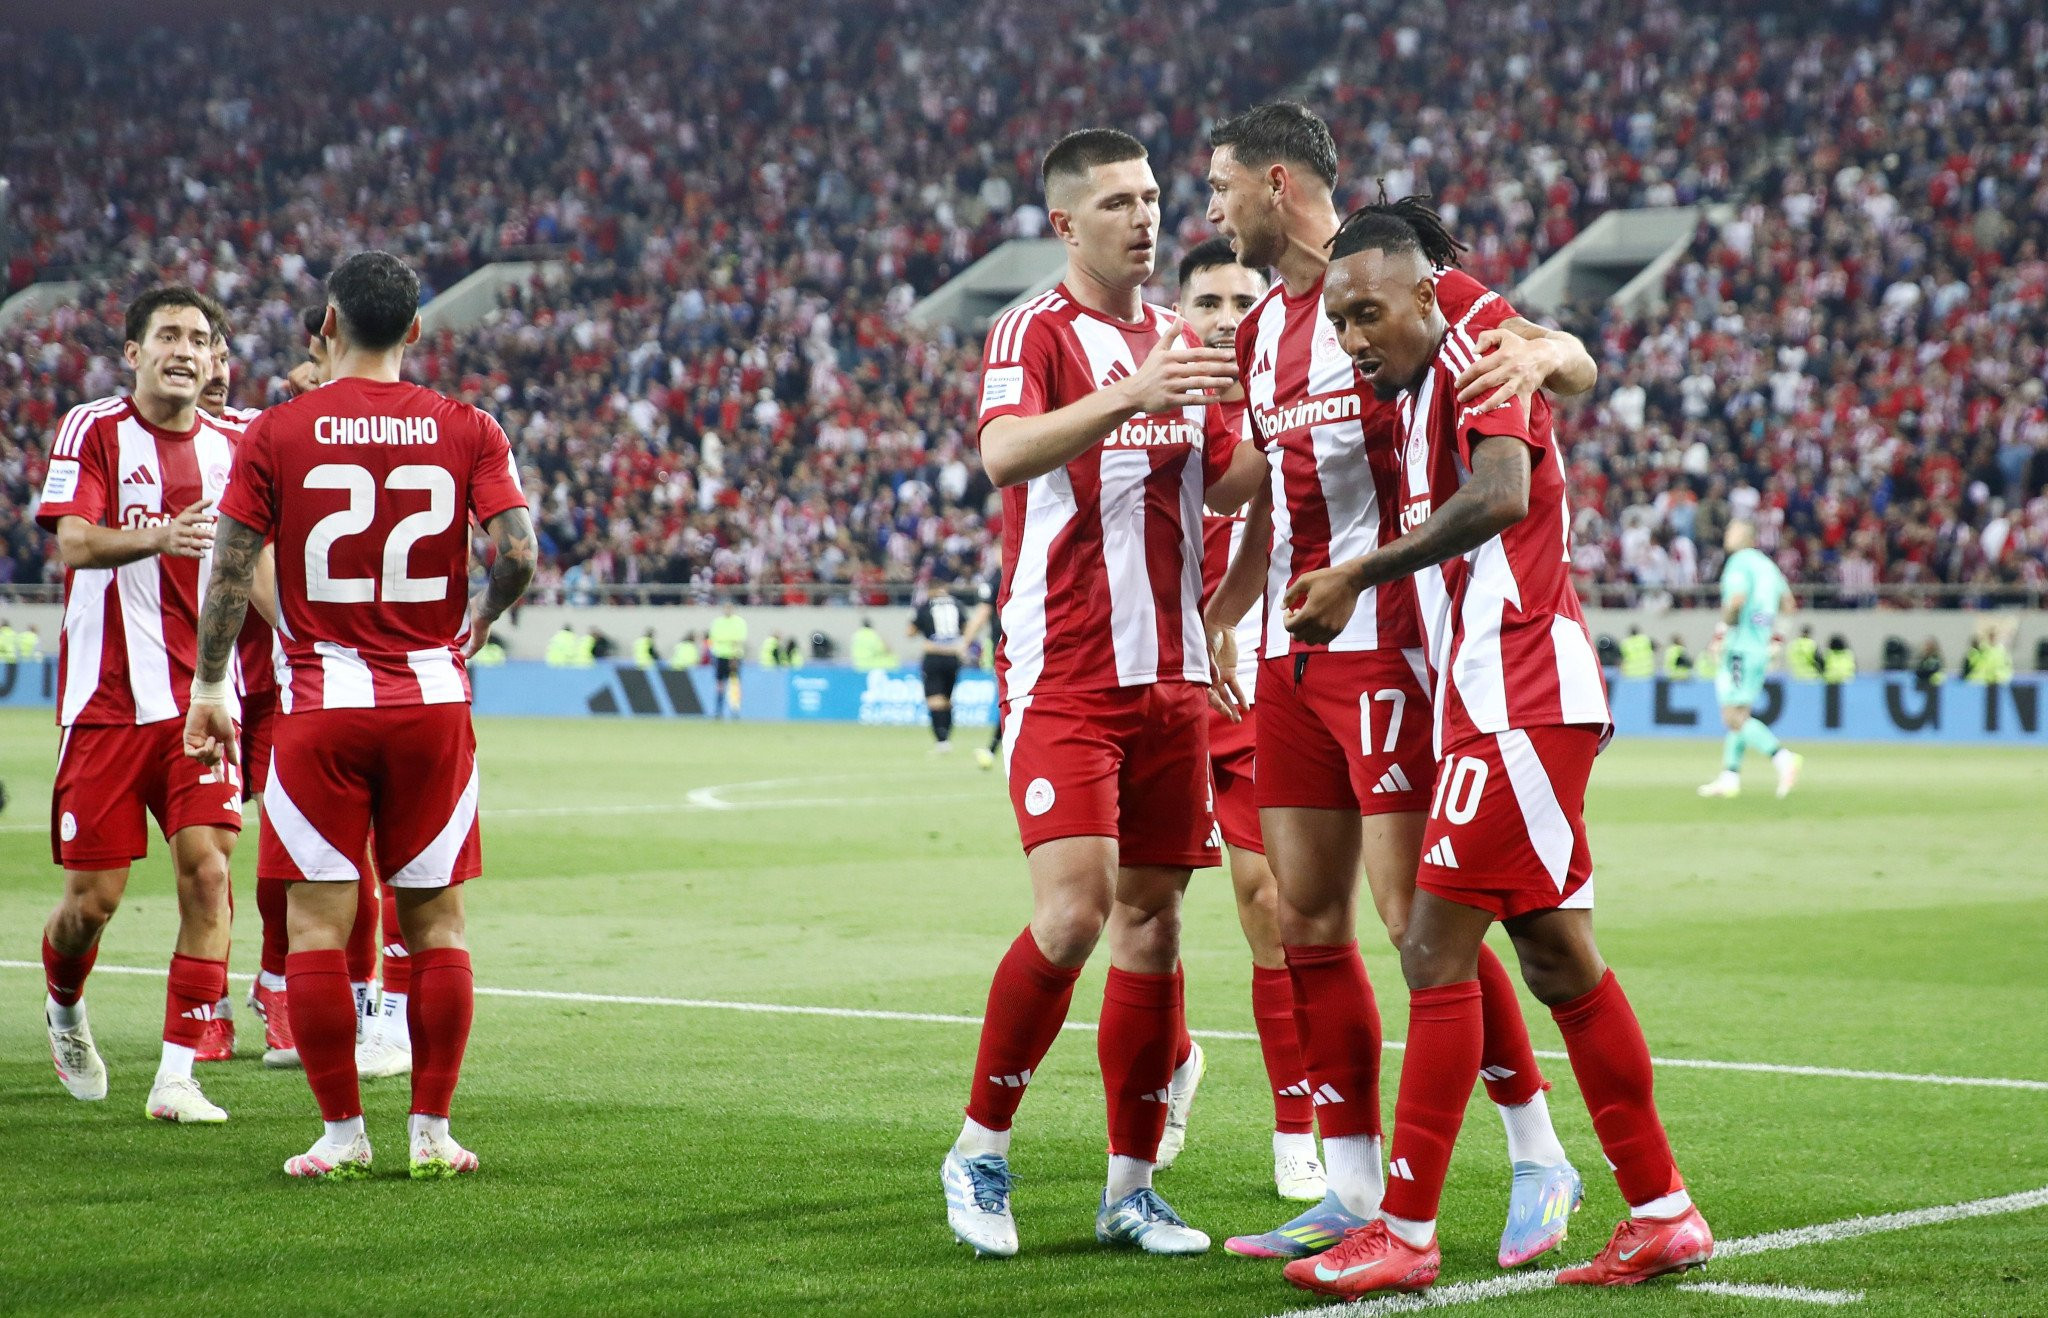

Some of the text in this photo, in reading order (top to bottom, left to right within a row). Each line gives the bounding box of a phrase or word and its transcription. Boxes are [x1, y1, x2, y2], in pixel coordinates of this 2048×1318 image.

[314, 415, 439, 445] CHIQUINHO
[303, 463, 456, 604] 22
[1359, 688, 1407, 756] 17
[1430, 753, 1489, 825] 10
